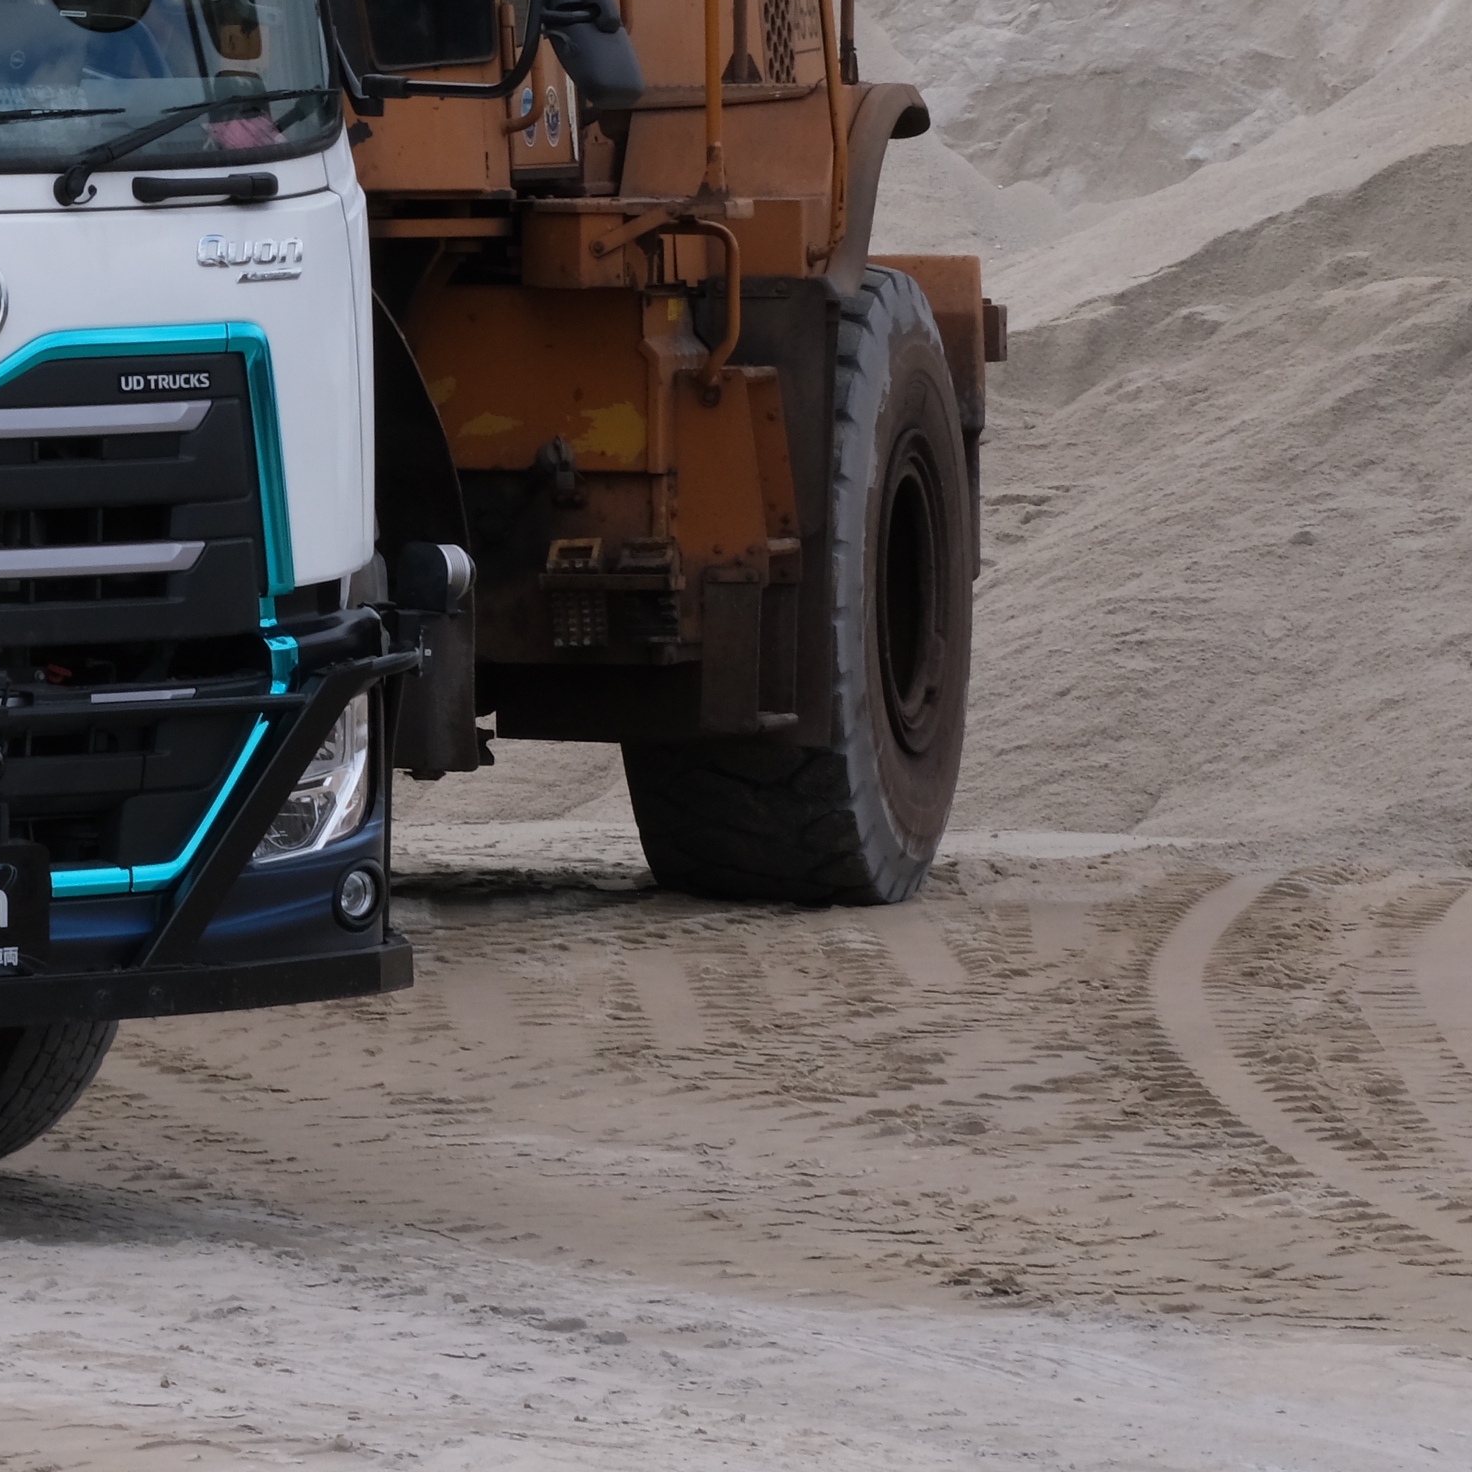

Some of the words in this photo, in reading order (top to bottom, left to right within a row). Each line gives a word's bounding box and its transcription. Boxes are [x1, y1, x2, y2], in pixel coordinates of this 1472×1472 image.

[196, 234, 303, 268] Quon
[120, 375, 145, 392] UD
[147, 372, 210, 391] TRUCKS
